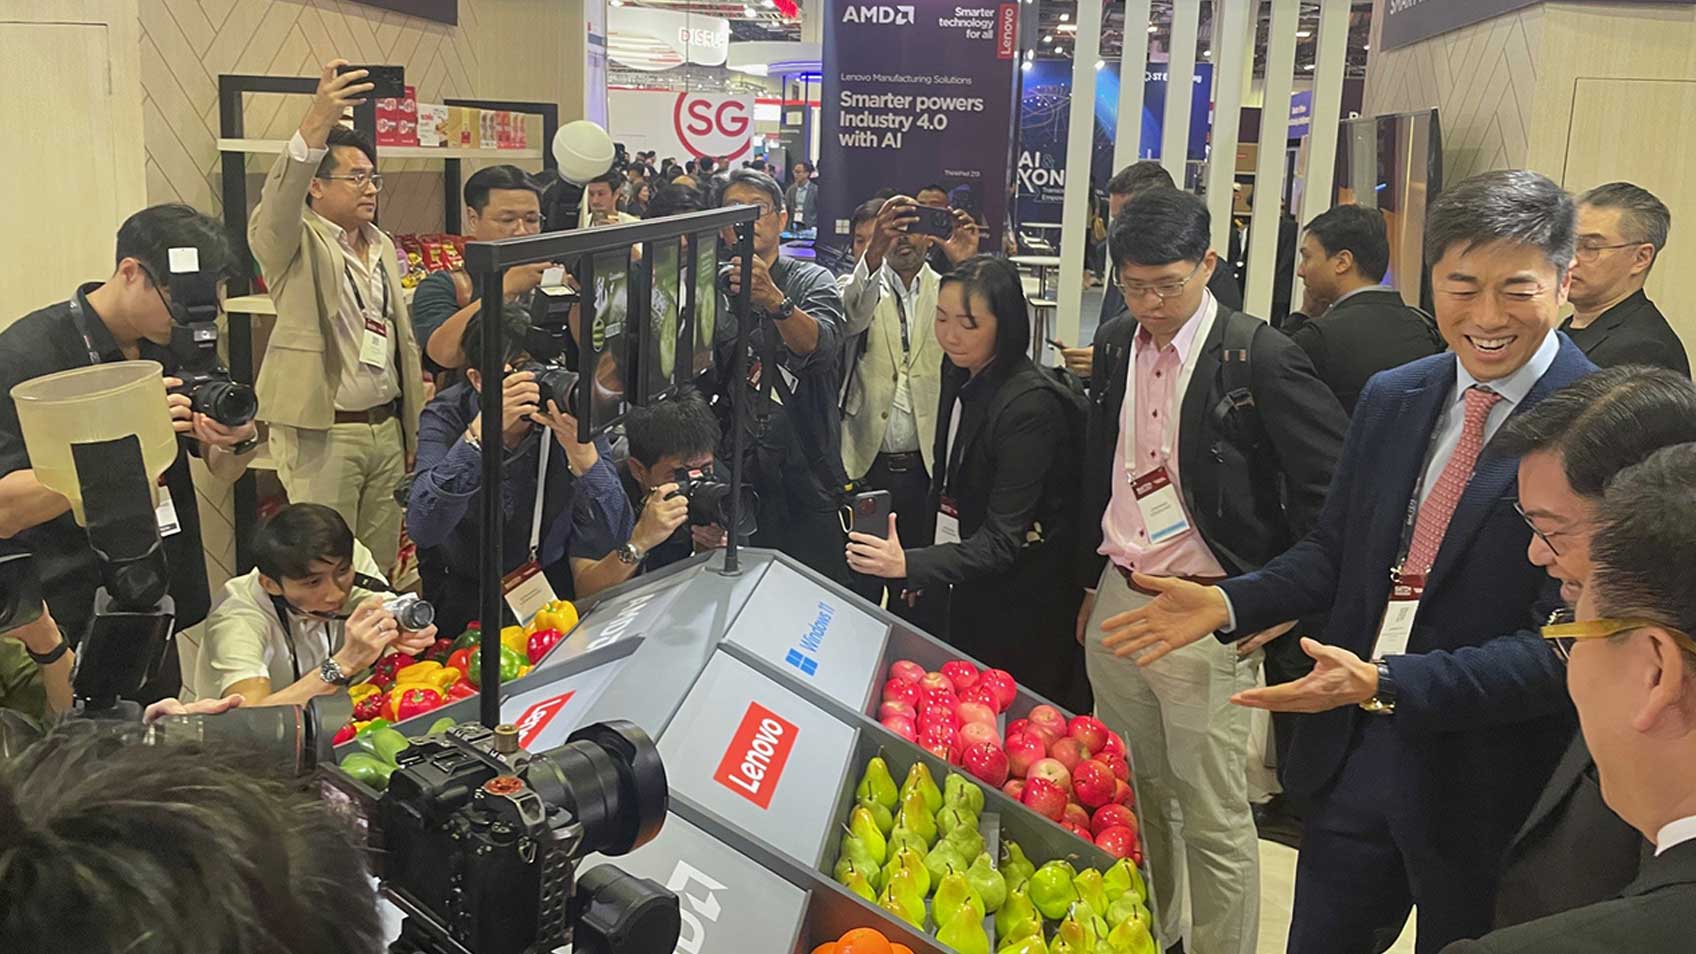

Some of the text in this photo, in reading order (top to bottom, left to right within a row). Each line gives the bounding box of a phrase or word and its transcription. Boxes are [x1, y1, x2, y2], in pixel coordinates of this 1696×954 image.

[842, 6, 894, 24] AMD
[955, 7, 995, 17] Smarter
[939, 18, 994, 30] technology
[1000, 8, 1014, 55] Lenovo
[966, 29, 993, 39] for all
[841, 73, 972, 85] Lenovo Manufacturing Solutions
[840, 90, 984, 112] Smarter powers
[686, 99, 749, 137] SG
[839, 110, 948, 132] Industry 4.0
[839, 130, 902, 148] with AI
[1018, 150, 1041, 168] AI
[799, 600, 836, 653] Windows 11
[728, 717, 784, 795] Lenovo
